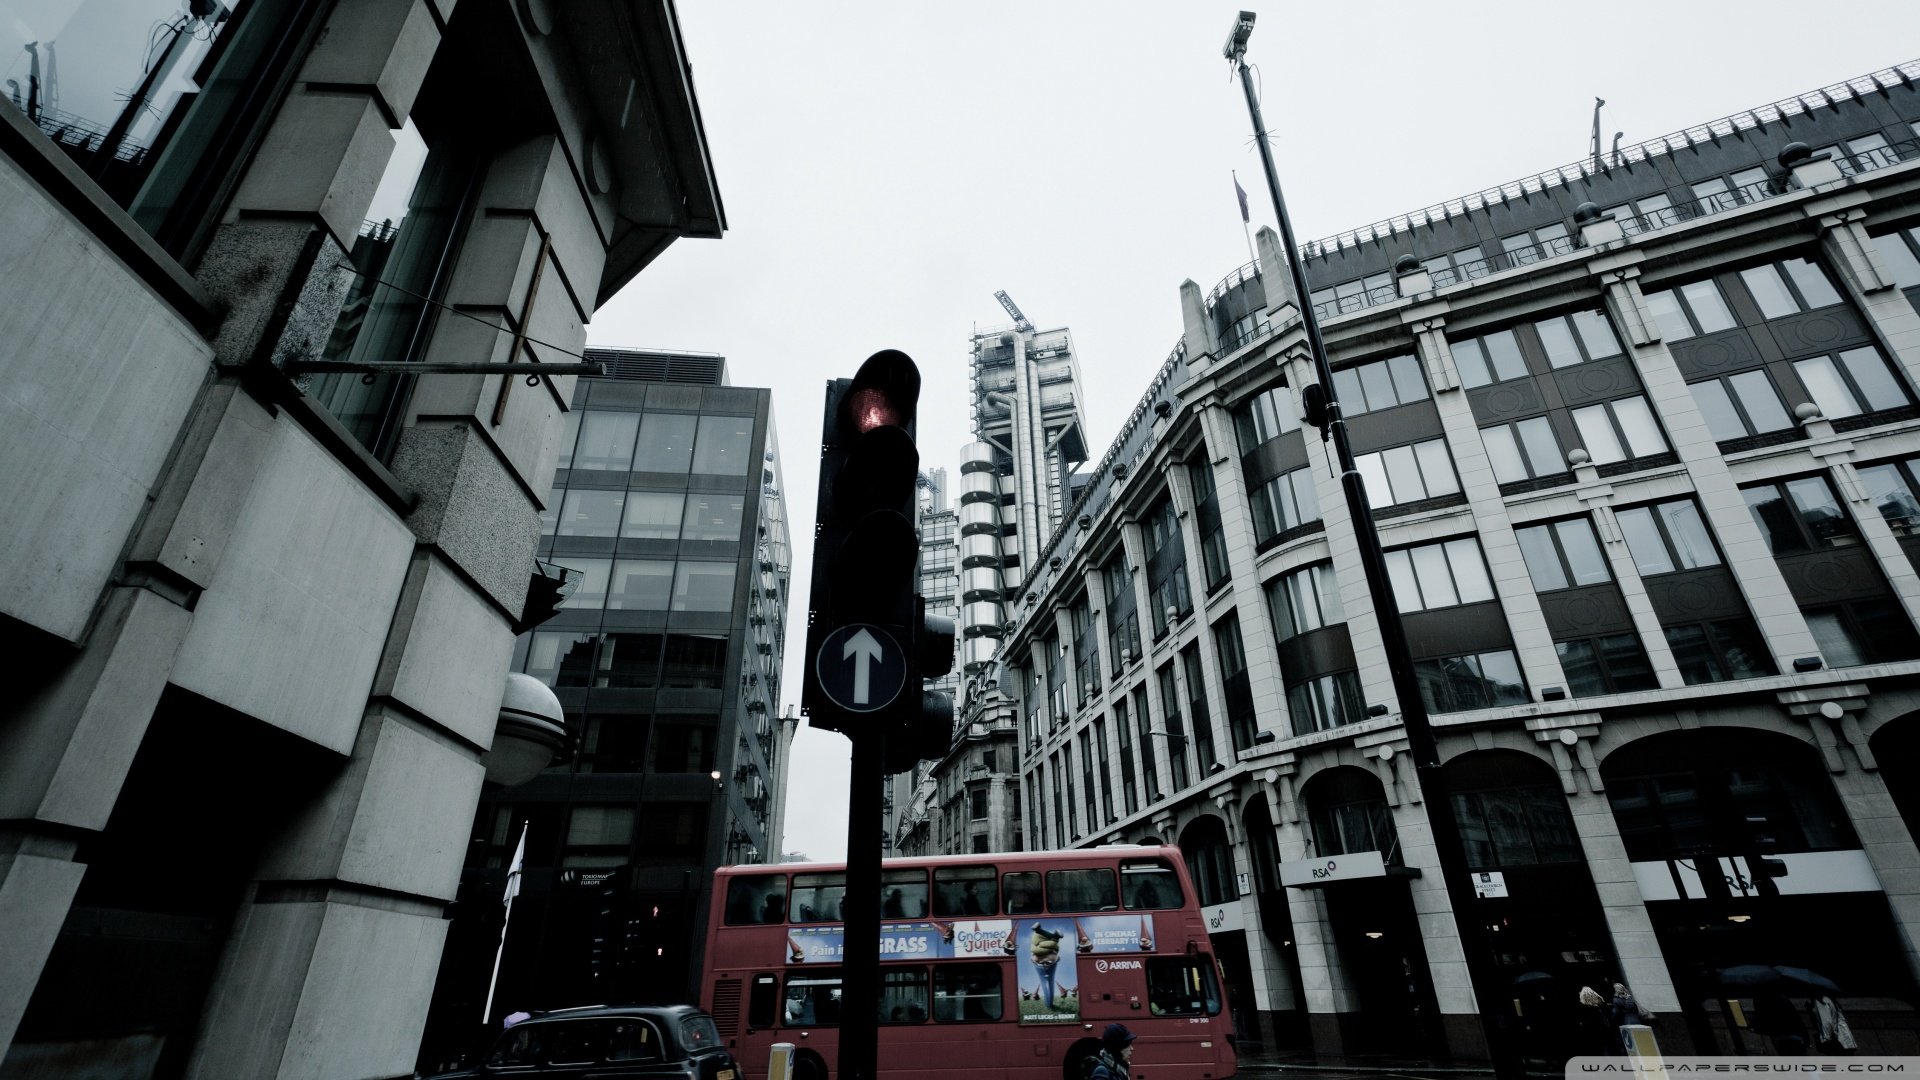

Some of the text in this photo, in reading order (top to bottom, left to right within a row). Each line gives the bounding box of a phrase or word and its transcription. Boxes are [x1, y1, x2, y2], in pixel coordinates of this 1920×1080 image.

[1312, 867, 1331, 878] RSA
[1211, 917, 1222, 928] RSA
[957, 930, 1007, 942] Gnomeo
[1104, 930, 1137, 938] CINEMAS
[965, 938, 1004, 953] Juliet
[1093, 937, 1129, 945] FEBRUARY
[811, 944, 834, 956] Pain
[1109, 961, 1143, 970] ARRIVA
